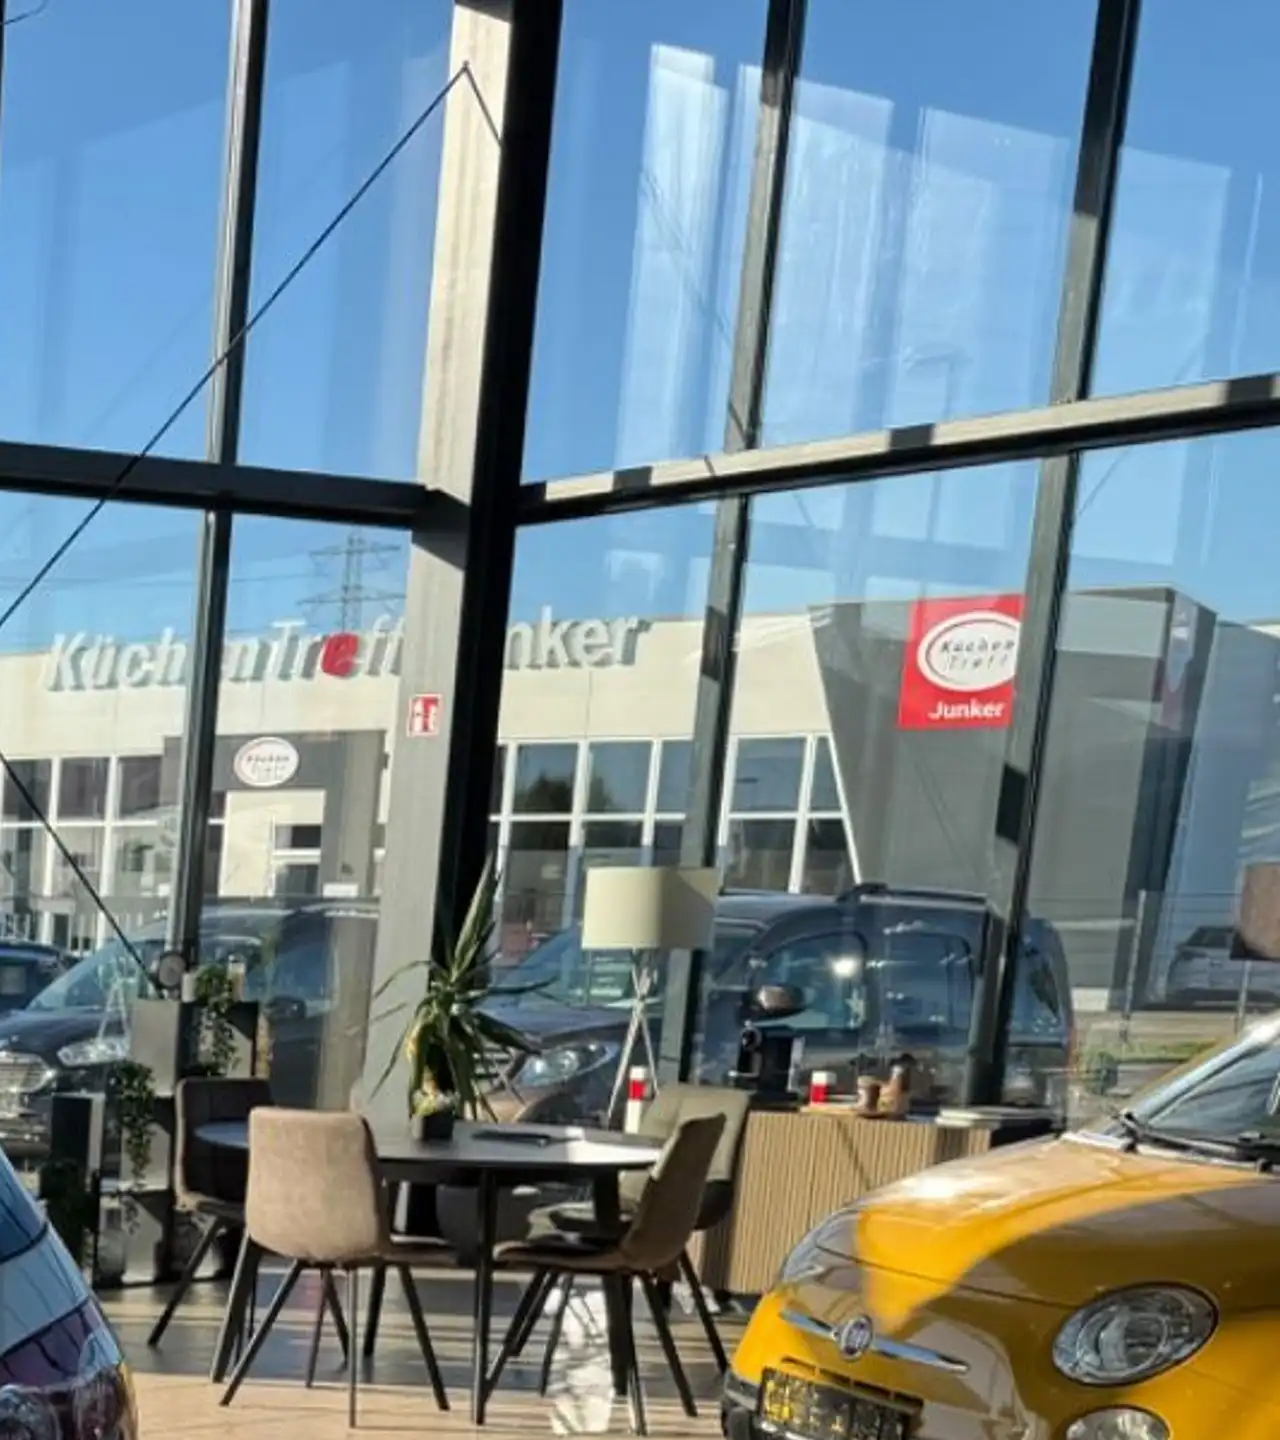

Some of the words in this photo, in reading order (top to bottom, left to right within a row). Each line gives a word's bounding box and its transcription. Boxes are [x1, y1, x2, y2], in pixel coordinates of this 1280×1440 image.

[43, 614, 403, 691] KüchnTreff
[502, 604, 644, 670] nker
[927, 698, 1006, 721] Junker
